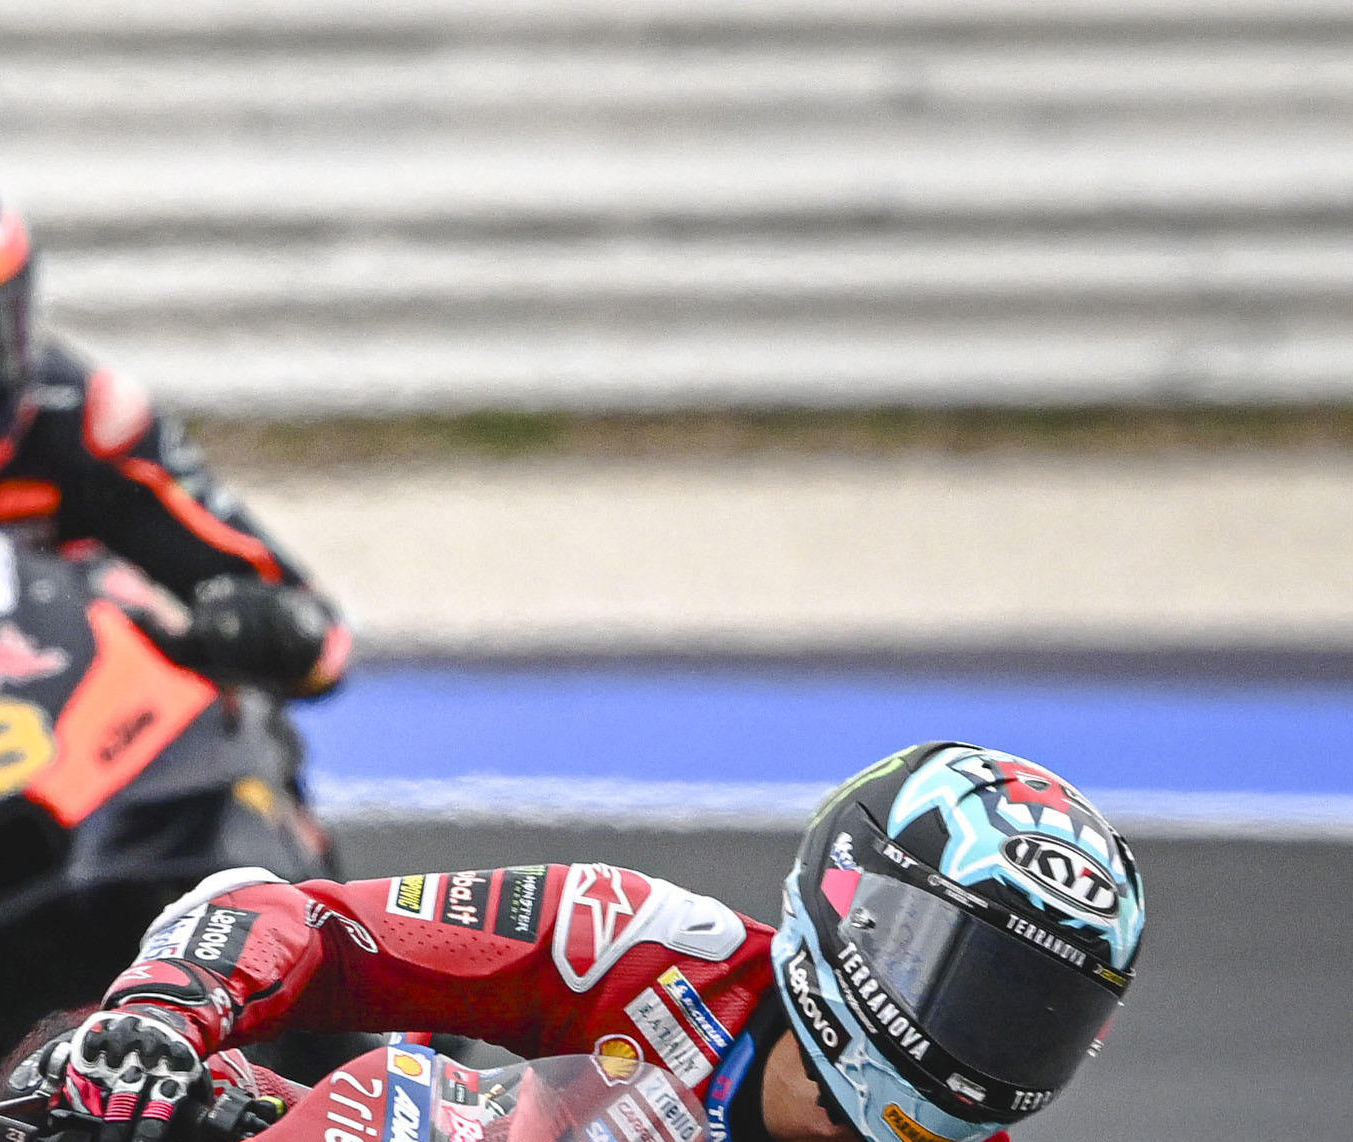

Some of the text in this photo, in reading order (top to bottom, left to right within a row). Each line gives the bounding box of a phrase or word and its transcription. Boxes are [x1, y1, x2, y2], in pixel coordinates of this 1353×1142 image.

[194, 908, 247, 960] Lenovo
[1005, 913, 1087, 968] TERRANOVA
[788, 950, 839, 1048] Lenovo
[837, 941, 931, 1061] TERRANOVA
